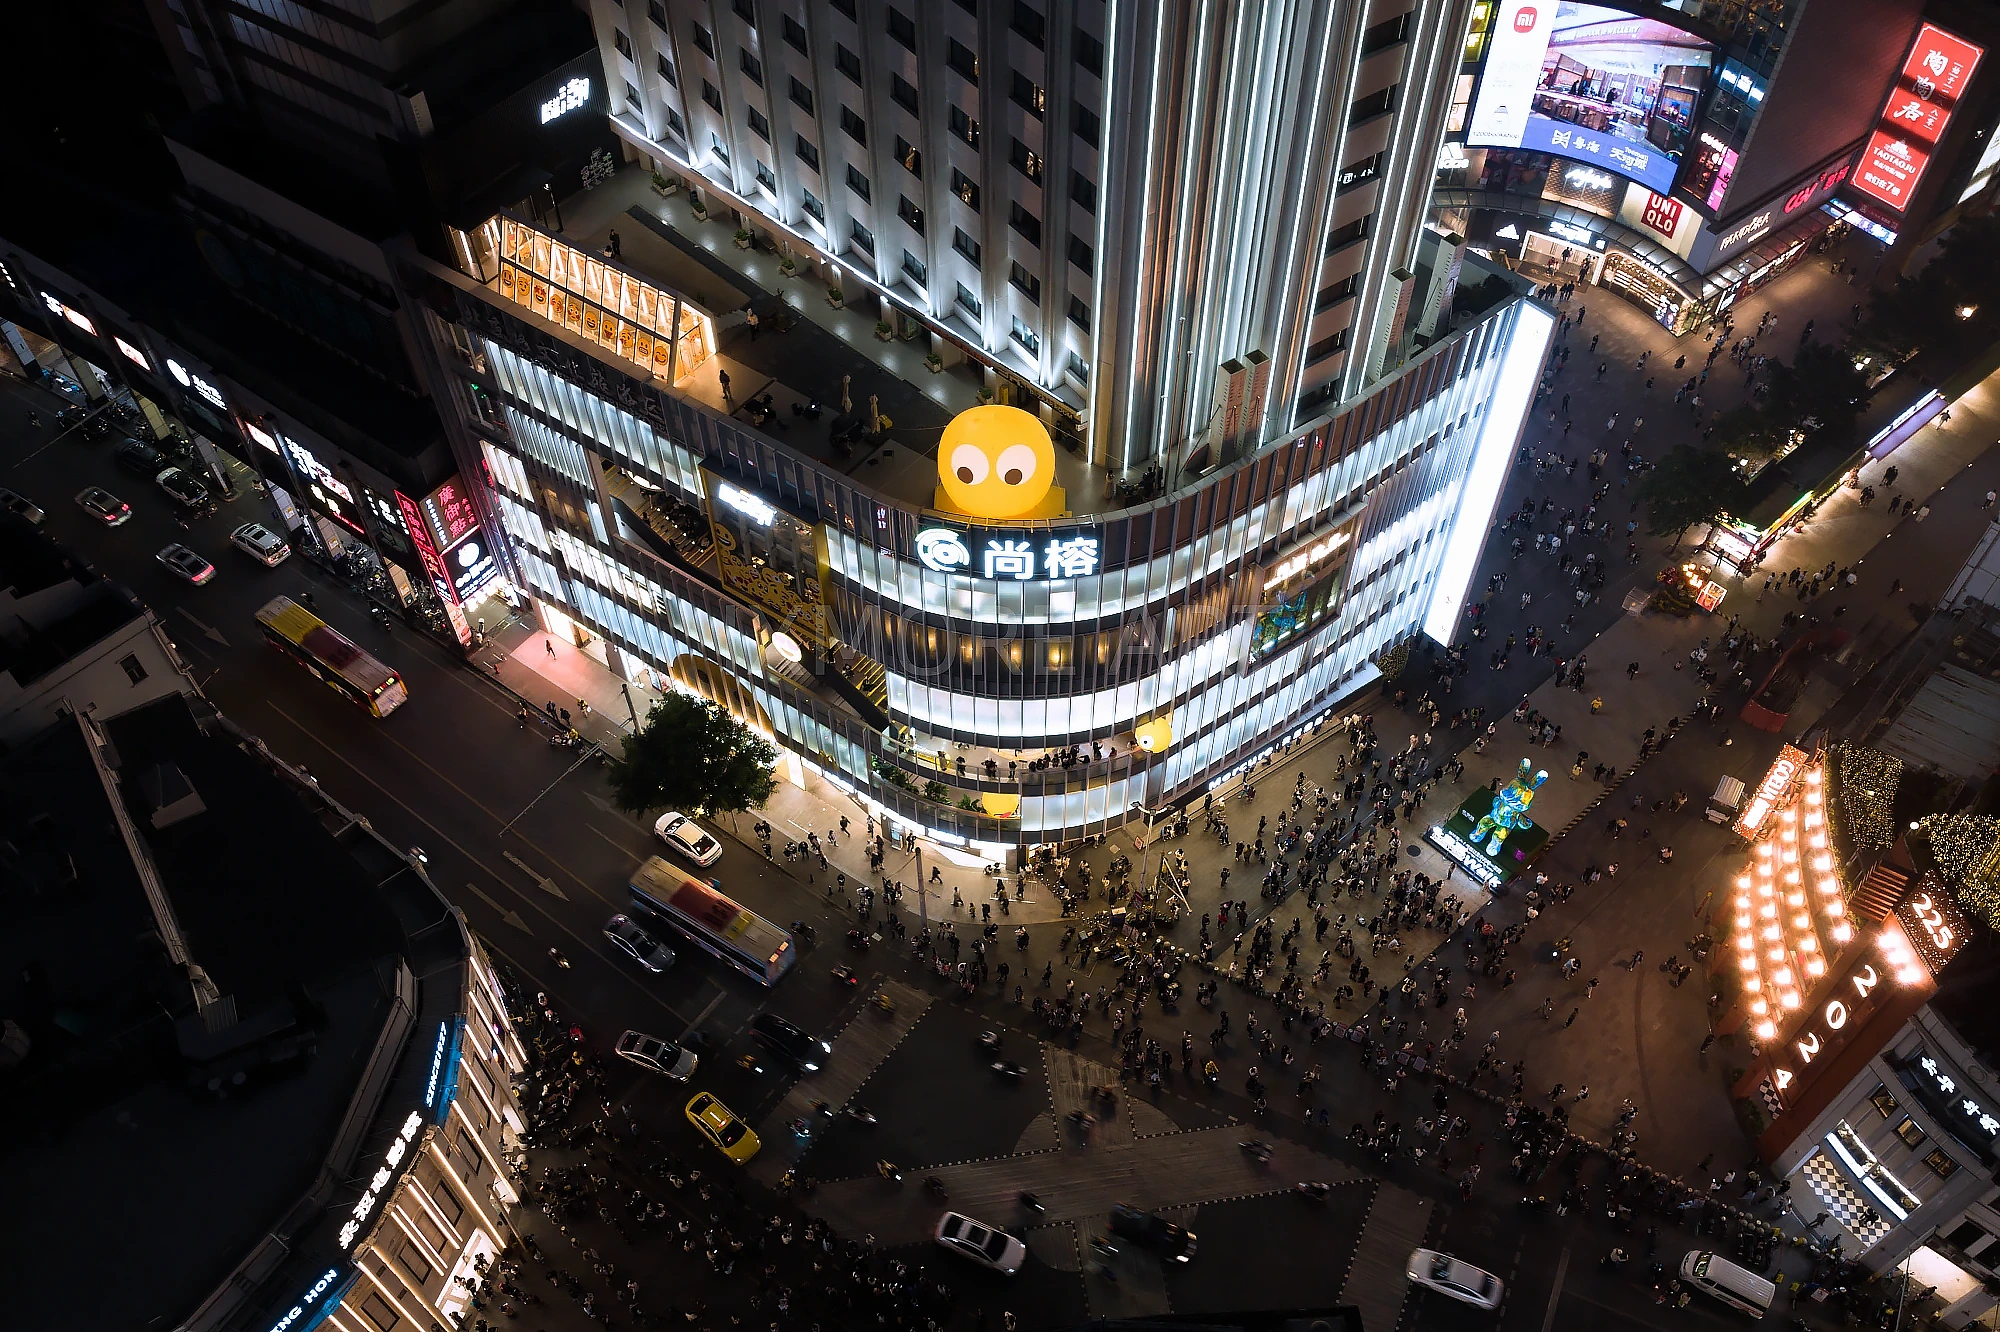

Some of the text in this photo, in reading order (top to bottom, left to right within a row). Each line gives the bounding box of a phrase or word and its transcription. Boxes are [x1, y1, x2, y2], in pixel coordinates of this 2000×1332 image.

[1893, 49, 1949, 122] 陶陶居
[1873, 146, 1917, 175] TAOTAOJU
[1651, 194, 1678, 217] UNI
[1784, 182, 1819, 215] CGV
[1646, 209, 1674, 233] QLO
[984, 536, 1099, 581] 尚榕
[1208, 746, 1274, 792] Mercure
[1463, 853, 1503, 888] Walk
[1912, 892, 1954, 950] 225
[338, 1110, 424, 1250] 永汉电影院
[303, 1268, 338, 1305] HON
